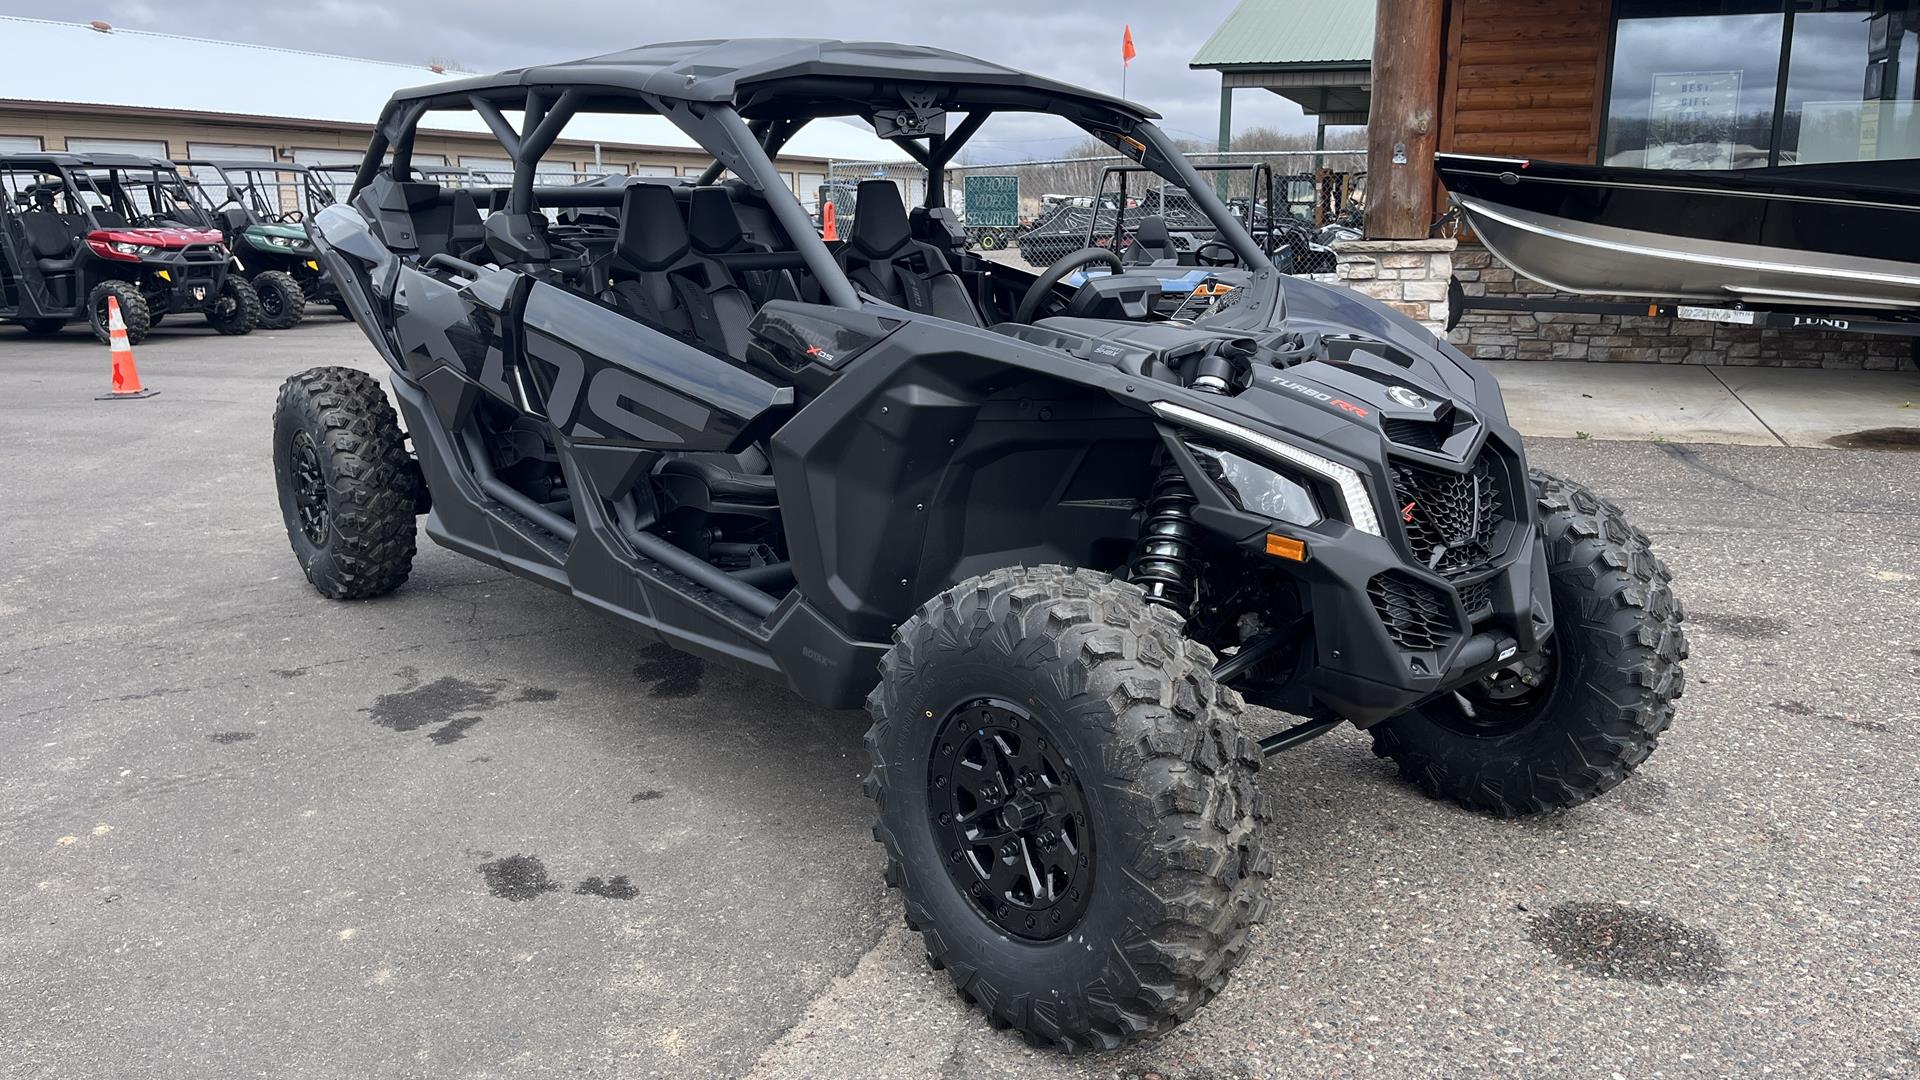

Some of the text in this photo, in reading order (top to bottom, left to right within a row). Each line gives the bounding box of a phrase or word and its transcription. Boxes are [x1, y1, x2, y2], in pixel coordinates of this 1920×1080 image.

[975, 194, 1008, 208] VIDEO
[966, 212, 1017, 225] SECURITY
[1794, 316, 1849, 330] LUND
[1270, 376, 1368, 419] TURBO RR
